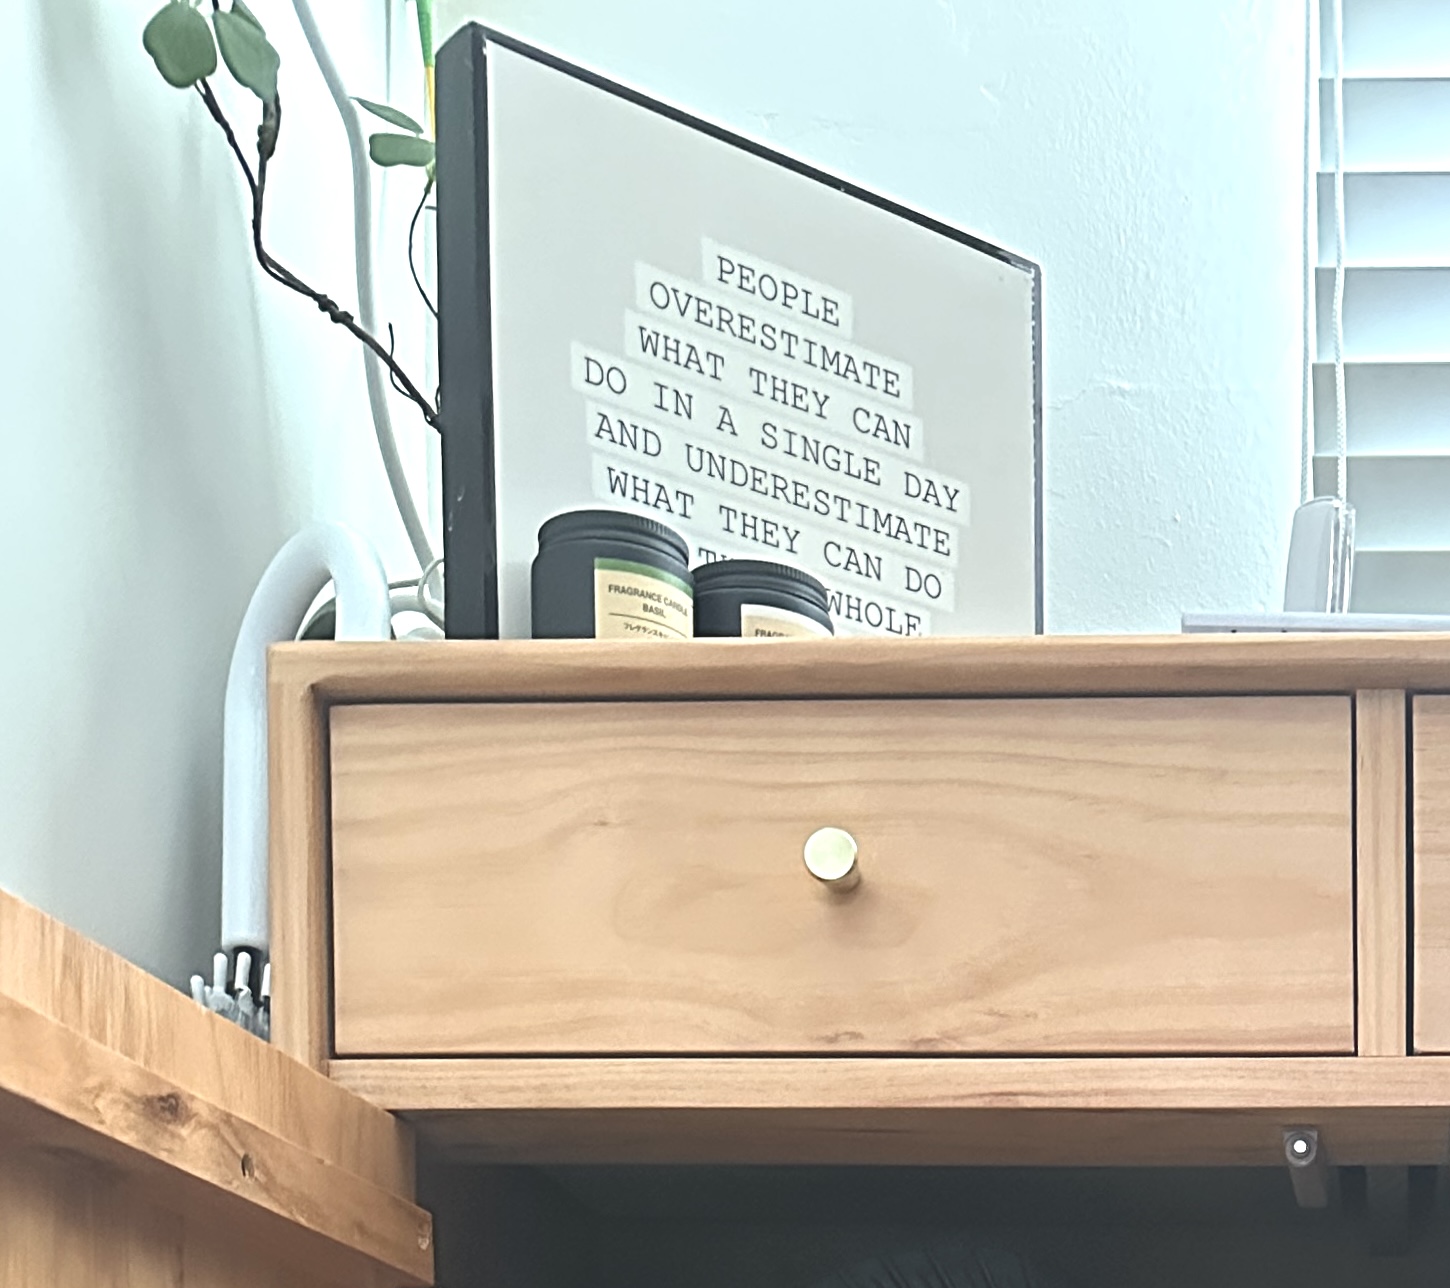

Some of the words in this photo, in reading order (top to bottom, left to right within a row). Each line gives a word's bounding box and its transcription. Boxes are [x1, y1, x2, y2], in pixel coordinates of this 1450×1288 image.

[649, 281, 901, 399] OVERESTIMATE
[717, 254, 840, 328] PEOPLE
[584, 356, 627, 395] DO
[653, 381, 693, 420] IN
[716, 404, 738, 437] A
[760, 421, 881, 487] SINGLE
[903, 470, 960, 513] DAY
[638, 325, 725, 381] WHAT
[749, 366, 830, 420] THEY
[852, 406, 911, 450] CAN
[594, 411, 662, 457] AND
[684, 442, 951, 557] UNDERESTIMATE
[606, 466, 695, 520] WHAT
[718, 504, 801, 554] THEY
[822, 540, 883, 582] CAN
[904, 565, 942, 600] DO
[607, 583, 663, 604] FRAGRANCE
[642, 602, 667, 619] BASIL
